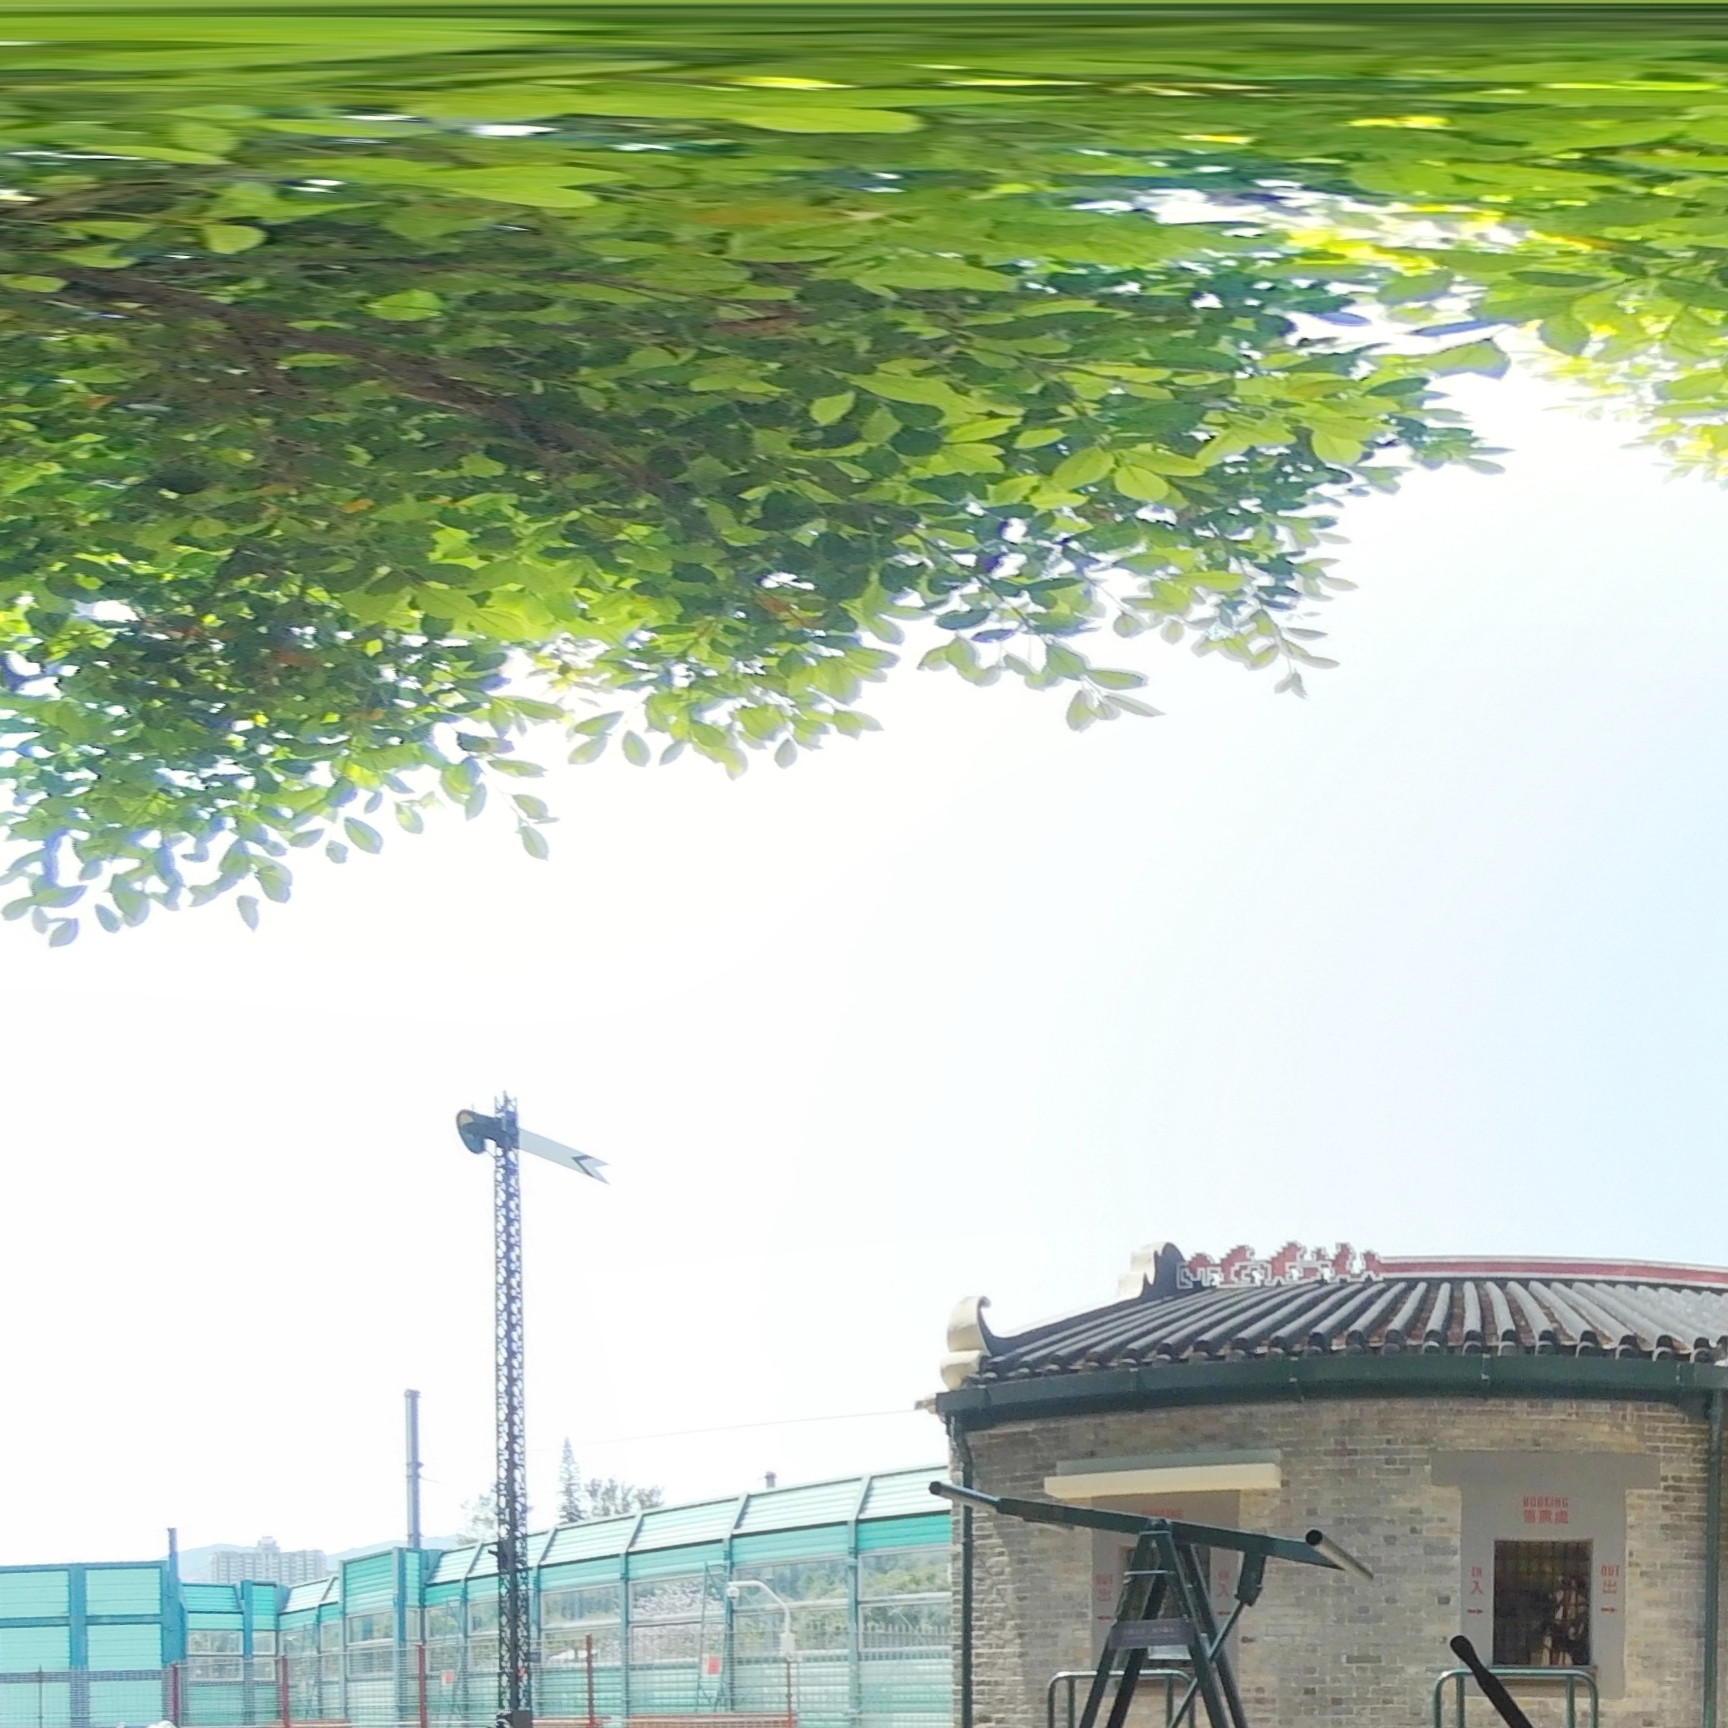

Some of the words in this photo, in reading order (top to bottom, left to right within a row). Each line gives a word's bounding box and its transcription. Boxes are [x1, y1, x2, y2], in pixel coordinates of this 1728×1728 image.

[1523, 1496, 1569, 1507] BOOKING
[1601, 1565, 1620, 1577] OUT
[1602, 1581, 1617, 1594] 出
